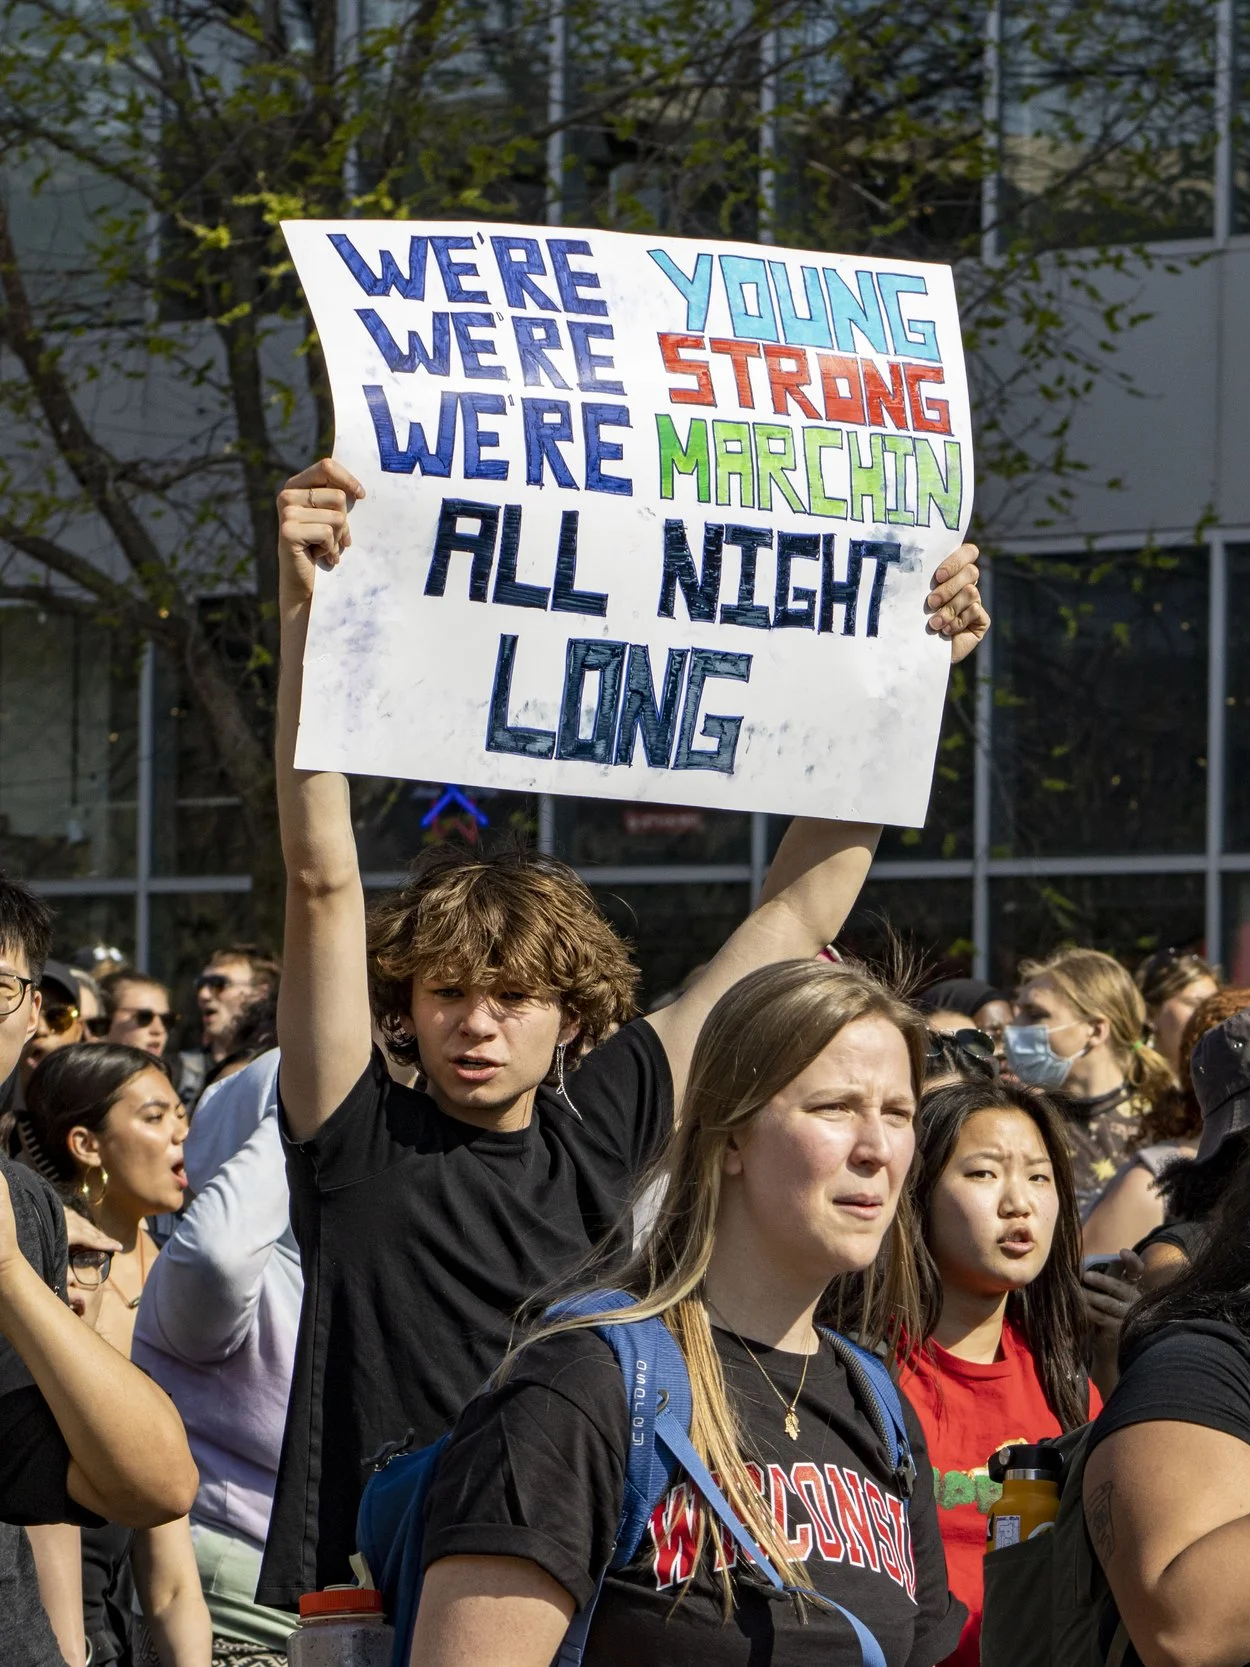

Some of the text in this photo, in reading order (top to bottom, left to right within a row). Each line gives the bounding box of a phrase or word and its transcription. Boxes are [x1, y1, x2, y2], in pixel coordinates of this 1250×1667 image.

[326, 233, 941, 362] WE'RE YOUNG
[353, 308, 951, 435] WE'RE STRONG
[362, 385, 961, 531] WE'RE MARCHIN
[423, 498, 902, 637] ALL NIGHT
[485, 634, 753, 774] LONG
